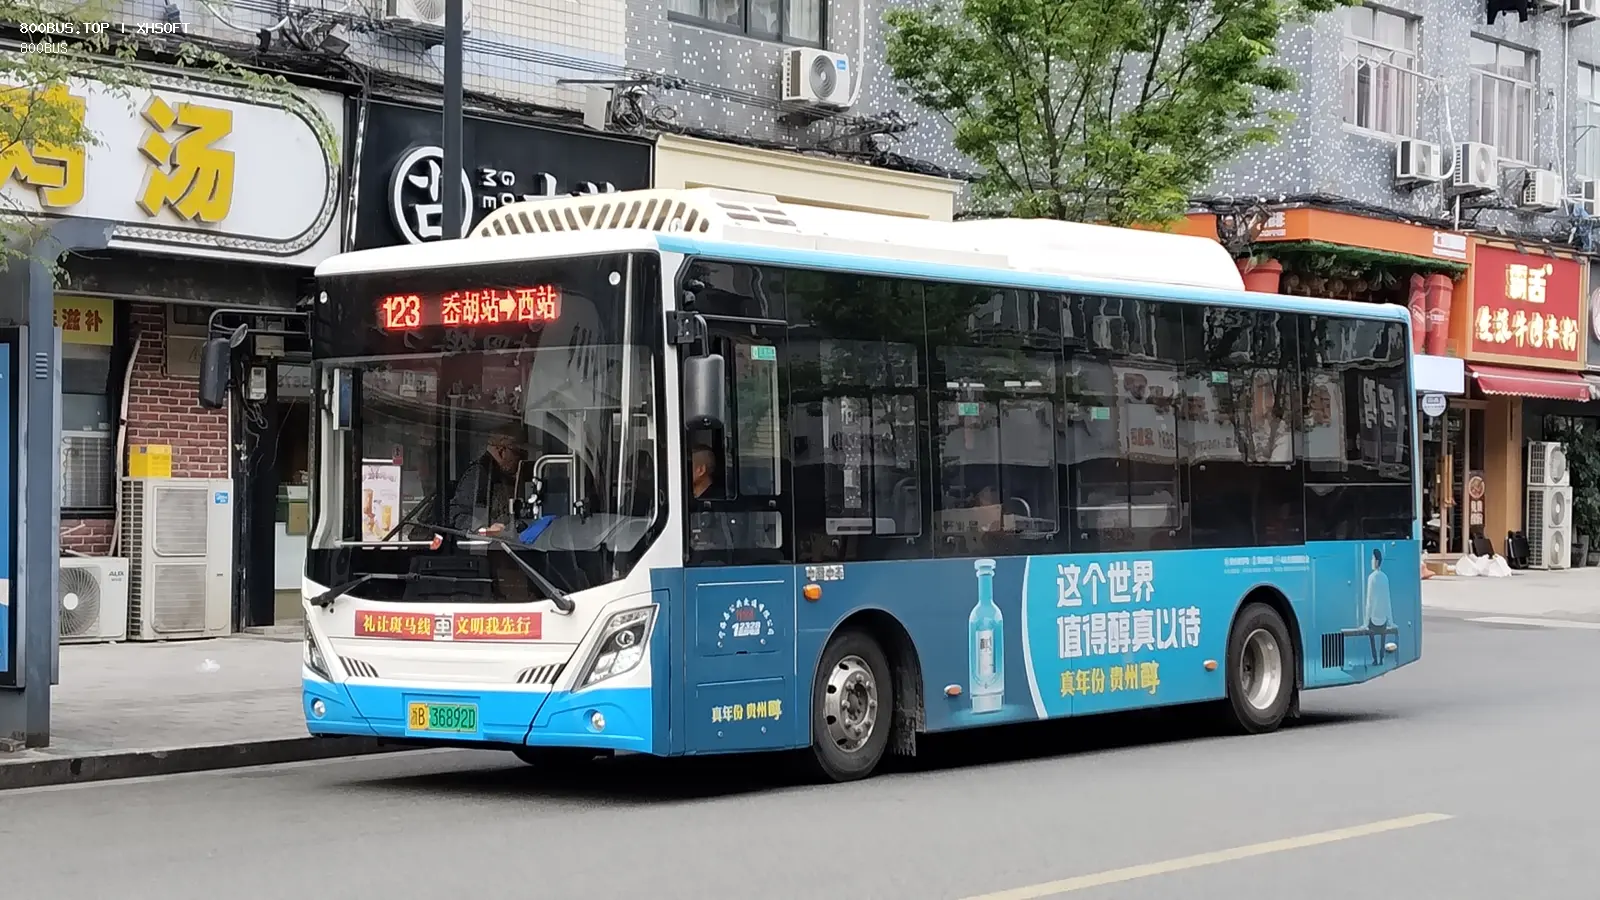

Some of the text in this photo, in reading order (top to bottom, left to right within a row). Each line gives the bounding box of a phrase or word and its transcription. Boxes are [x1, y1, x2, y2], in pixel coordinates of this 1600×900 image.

[382, 294, 421, 328] 123
[516, 284, 557, 321] 西站
[1056, 560, 1155, 608] 这个世界
[363, 614, 431, 635] 礼让斑马线
[456, 616, 531, 635] 文明我先行
[1056, 605, 1201, 659] 值得醇真以待
[1060, 660, 1161, 697] 真年份 贵州醇
[712, 704, 744, 723] 真年份
